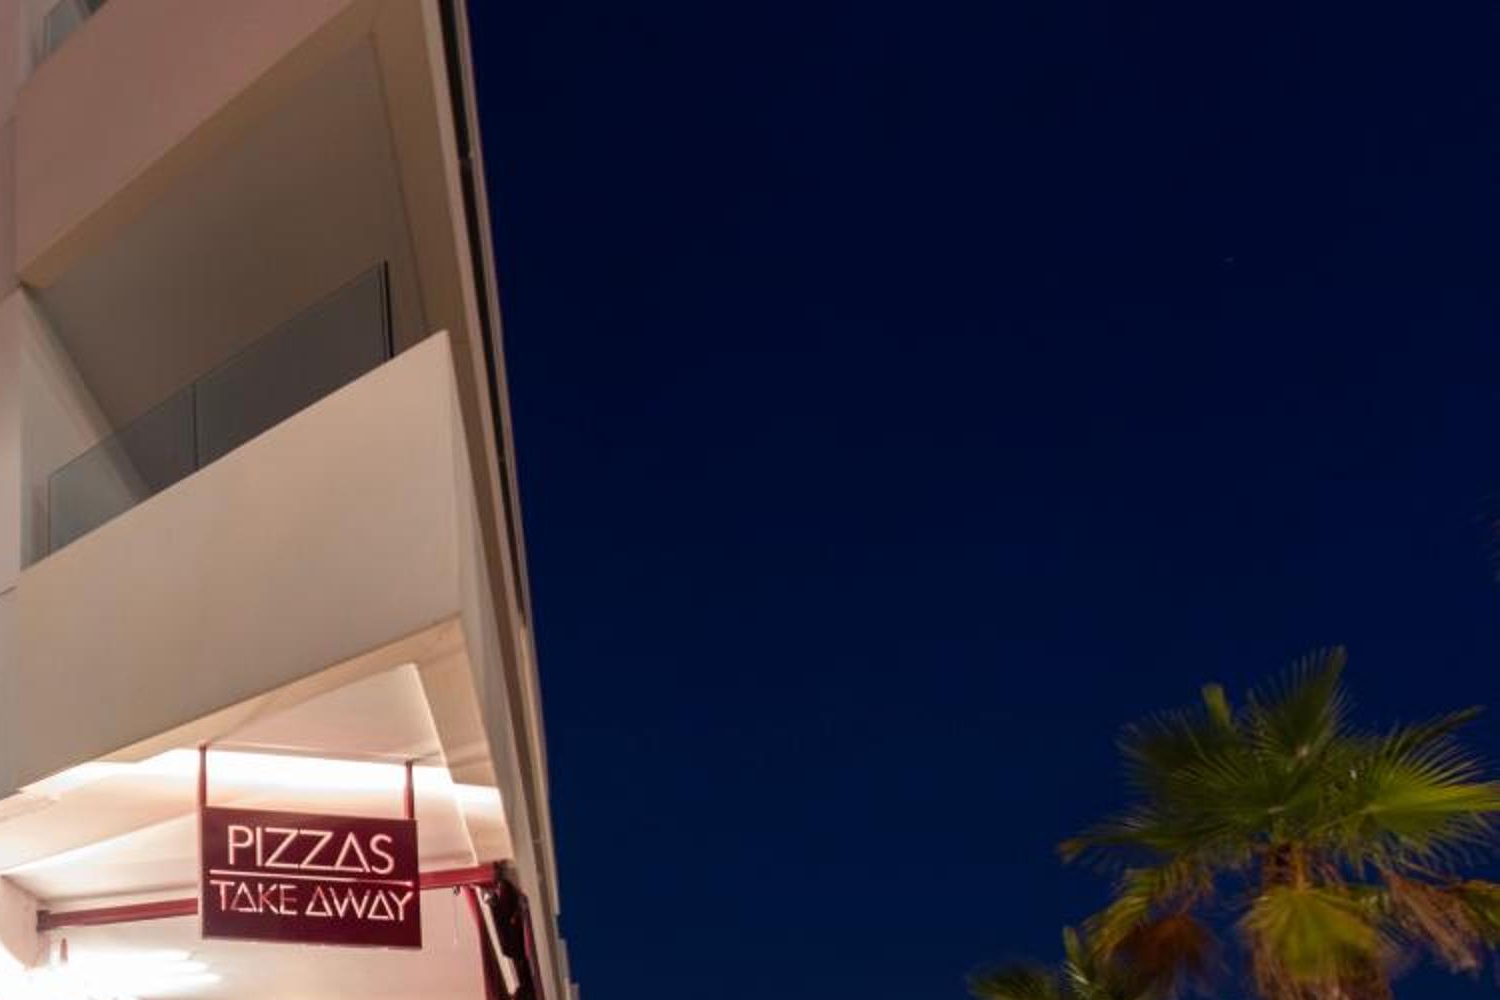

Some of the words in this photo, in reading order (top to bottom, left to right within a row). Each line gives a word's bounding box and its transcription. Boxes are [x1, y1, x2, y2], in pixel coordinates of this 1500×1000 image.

[227, 825, 395, 875] PIZZAS
[210, 879, 297, 916] TAKE
[305, 886, 414, 921] AWAY
